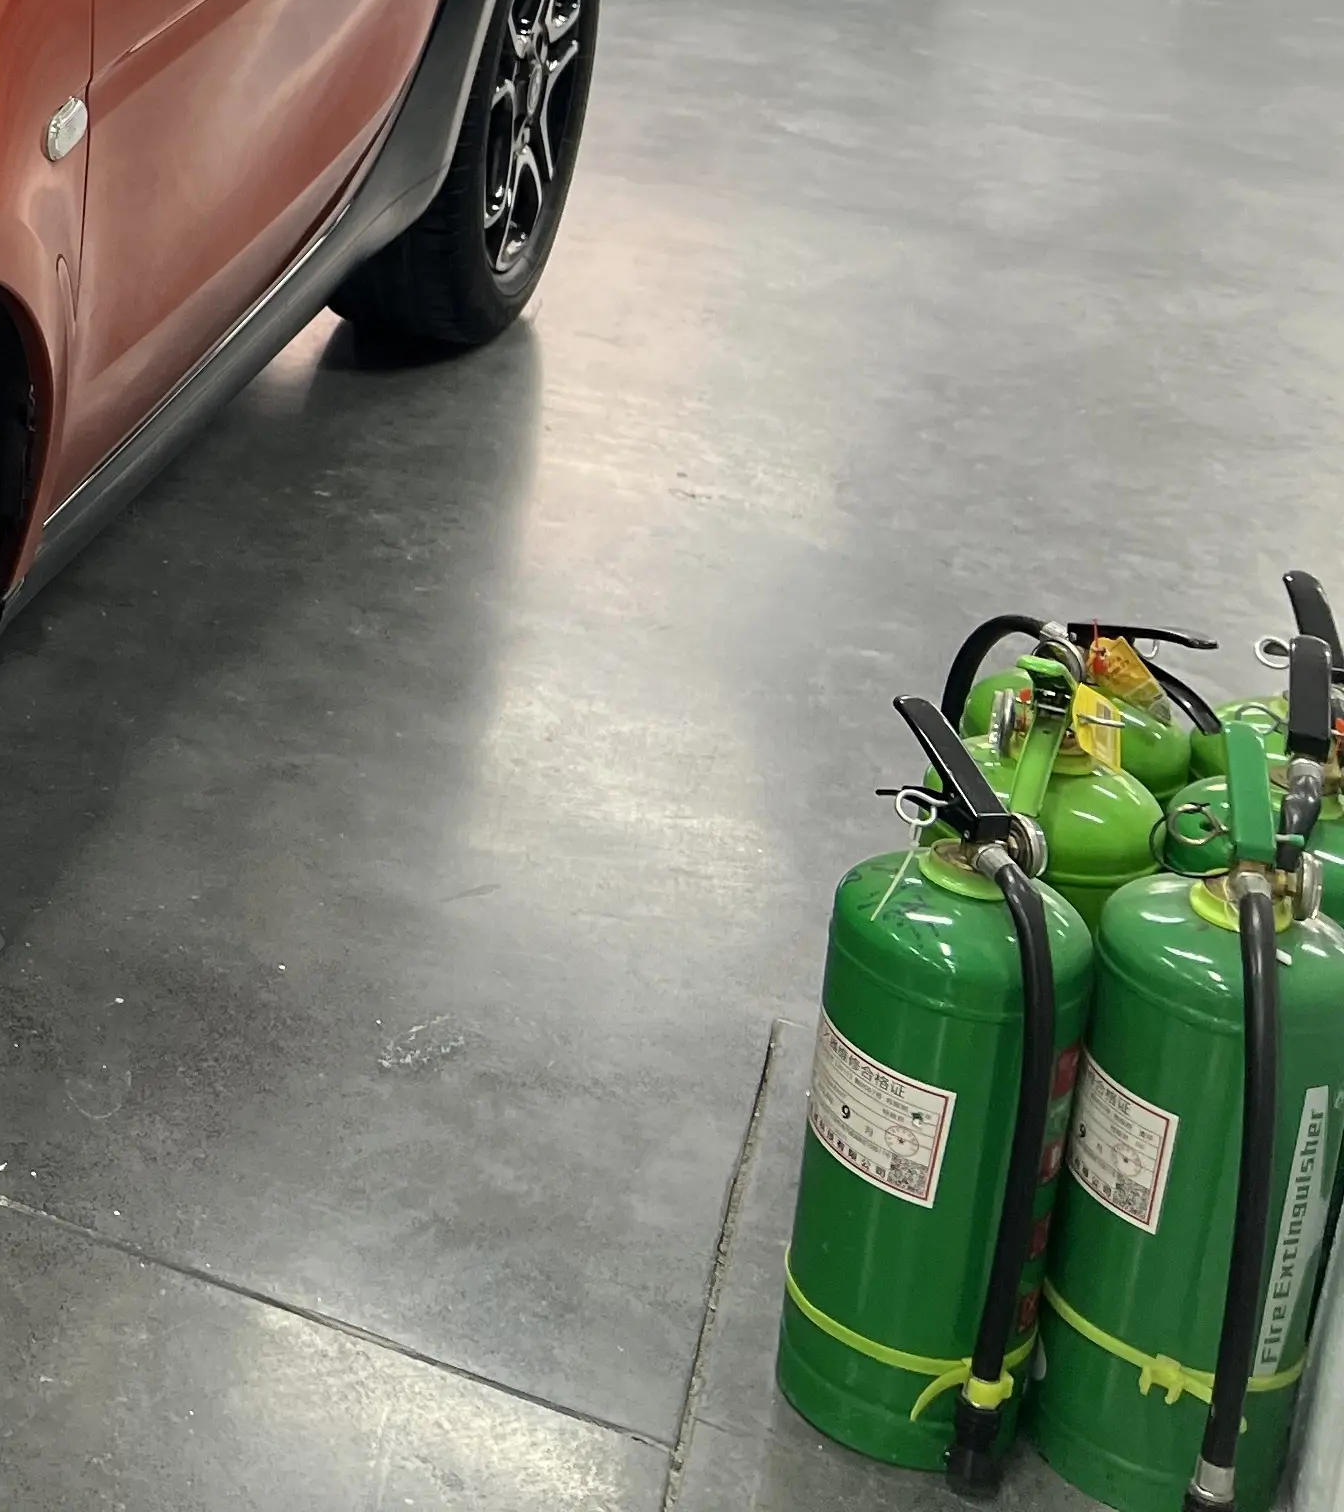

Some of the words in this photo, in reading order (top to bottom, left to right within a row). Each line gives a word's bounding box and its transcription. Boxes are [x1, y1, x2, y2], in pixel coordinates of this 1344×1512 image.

[841, 1104, 851, 1120] 9
[1272, 1108, 1325, 1301] Extinguisher
[1260, 1302, 1287, 1365] Fire
